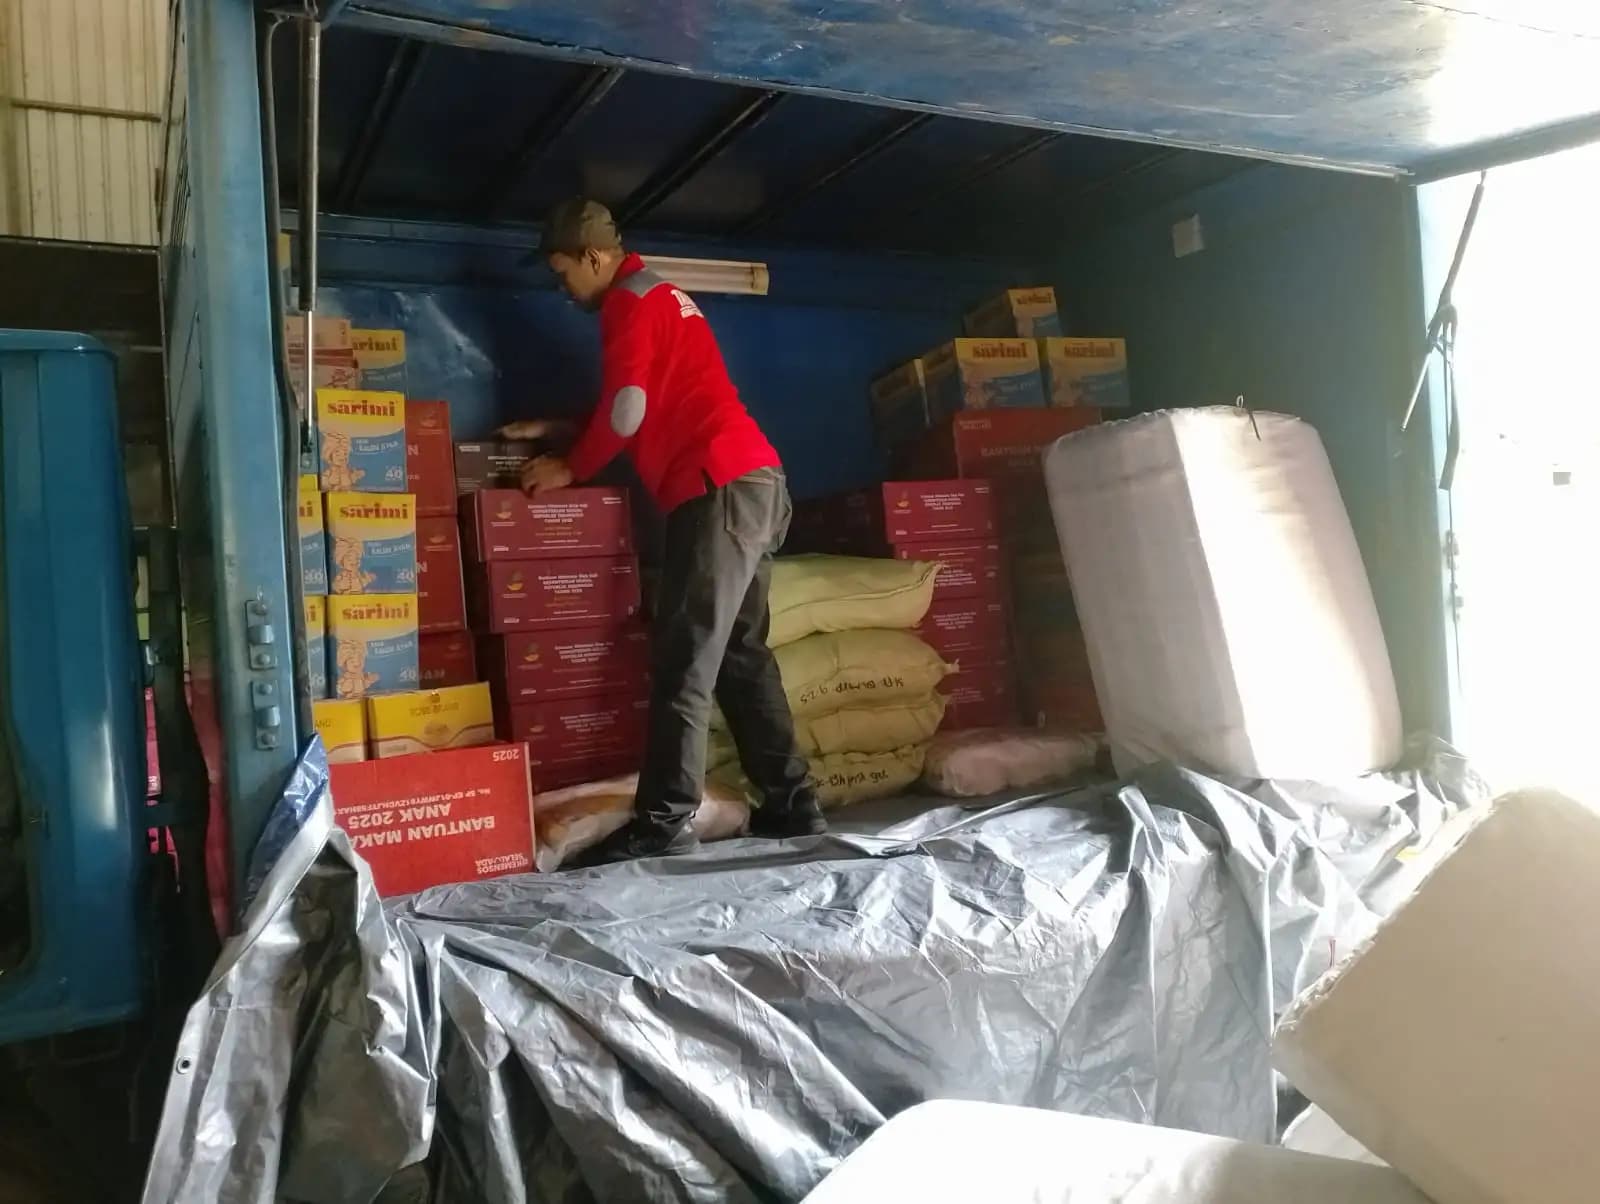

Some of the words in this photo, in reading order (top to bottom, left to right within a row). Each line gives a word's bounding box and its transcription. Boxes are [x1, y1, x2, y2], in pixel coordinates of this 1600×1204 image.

[352, 336, 398, 351] arimi
[327, 400, 395, 416] sarimi
[339, 503, 408, 519] sarimi
[342, 603, 409, 619] sarimi
[492, 748, 520, 762] 2025
[347, 811, 394, 829] 2025
[399, 803, 452, 823] ANAK
[408, 815, 496, 841] BANTUAN
